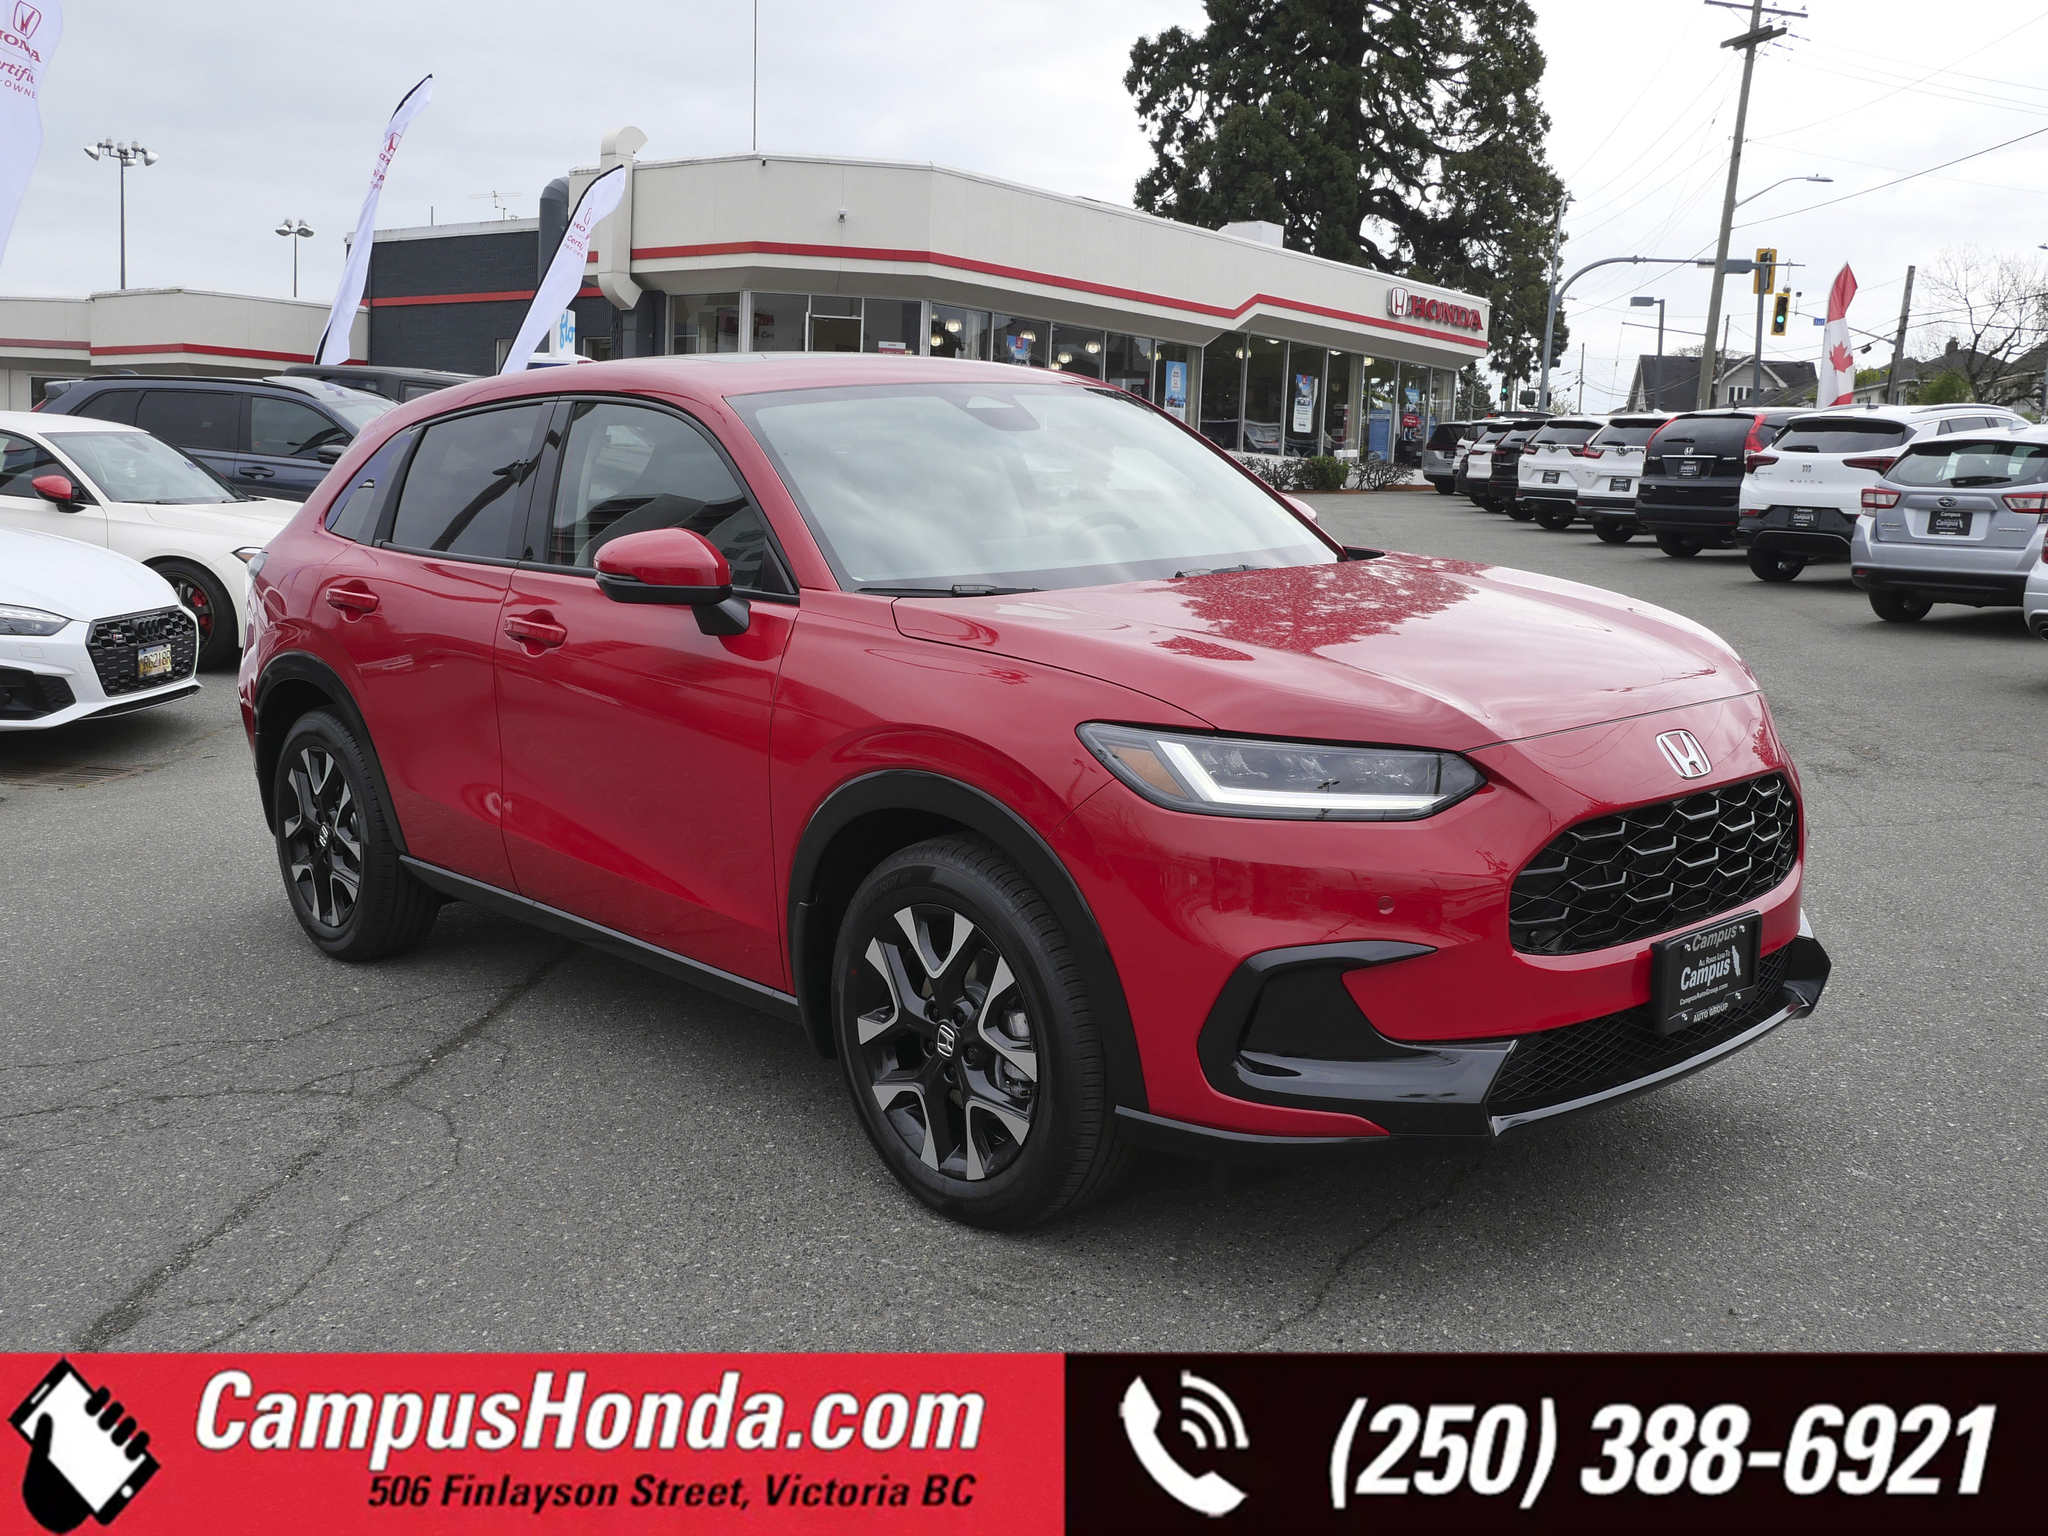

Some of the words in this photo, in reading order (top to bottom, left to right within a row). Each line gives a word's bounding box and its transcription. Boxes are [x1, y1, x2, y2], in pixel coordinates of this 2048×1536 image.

[1410, 294, 1484, 331] HONDA
[1935, 519, 1959, 528] Campus
[1691, 925, 1738, 952] Campus
[1680, 958, 1731, 991] Campus
[1692, 1010, 1709, 1023] AUTO
[1708, 1002, 1729, 1017] GROUP
